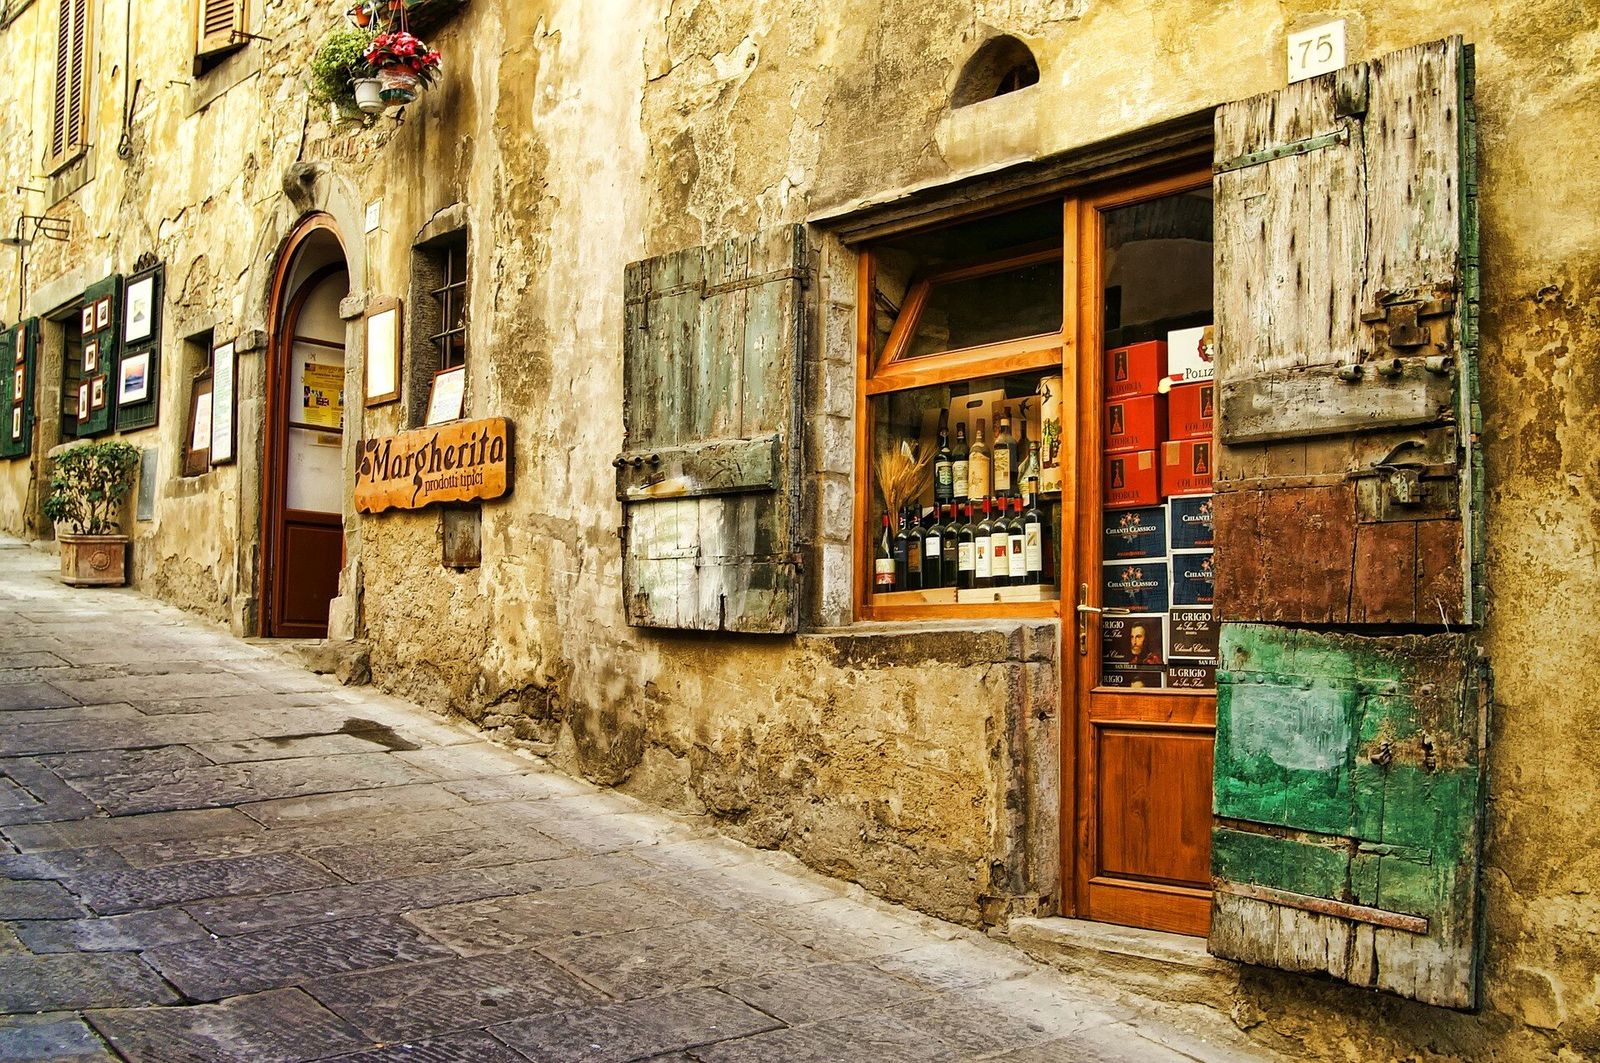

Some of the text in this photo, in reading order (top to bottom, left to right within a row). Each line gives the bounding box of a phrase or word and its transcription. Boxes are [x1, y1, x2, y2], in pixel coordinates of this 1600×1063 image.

[1298, 33, 1333, 68] 75
[1185, 367, 1214, 379] POLIZ
[370, 427, 504, 507] Margherita
[424, 467, 483, 496] prodotti tipici
[1172, 612, 1211, 621] IL GRIGIO
[1103, 620, 1125, 629] RIGIO
[1169, 668, 1207, 678] IL GRIGIO
